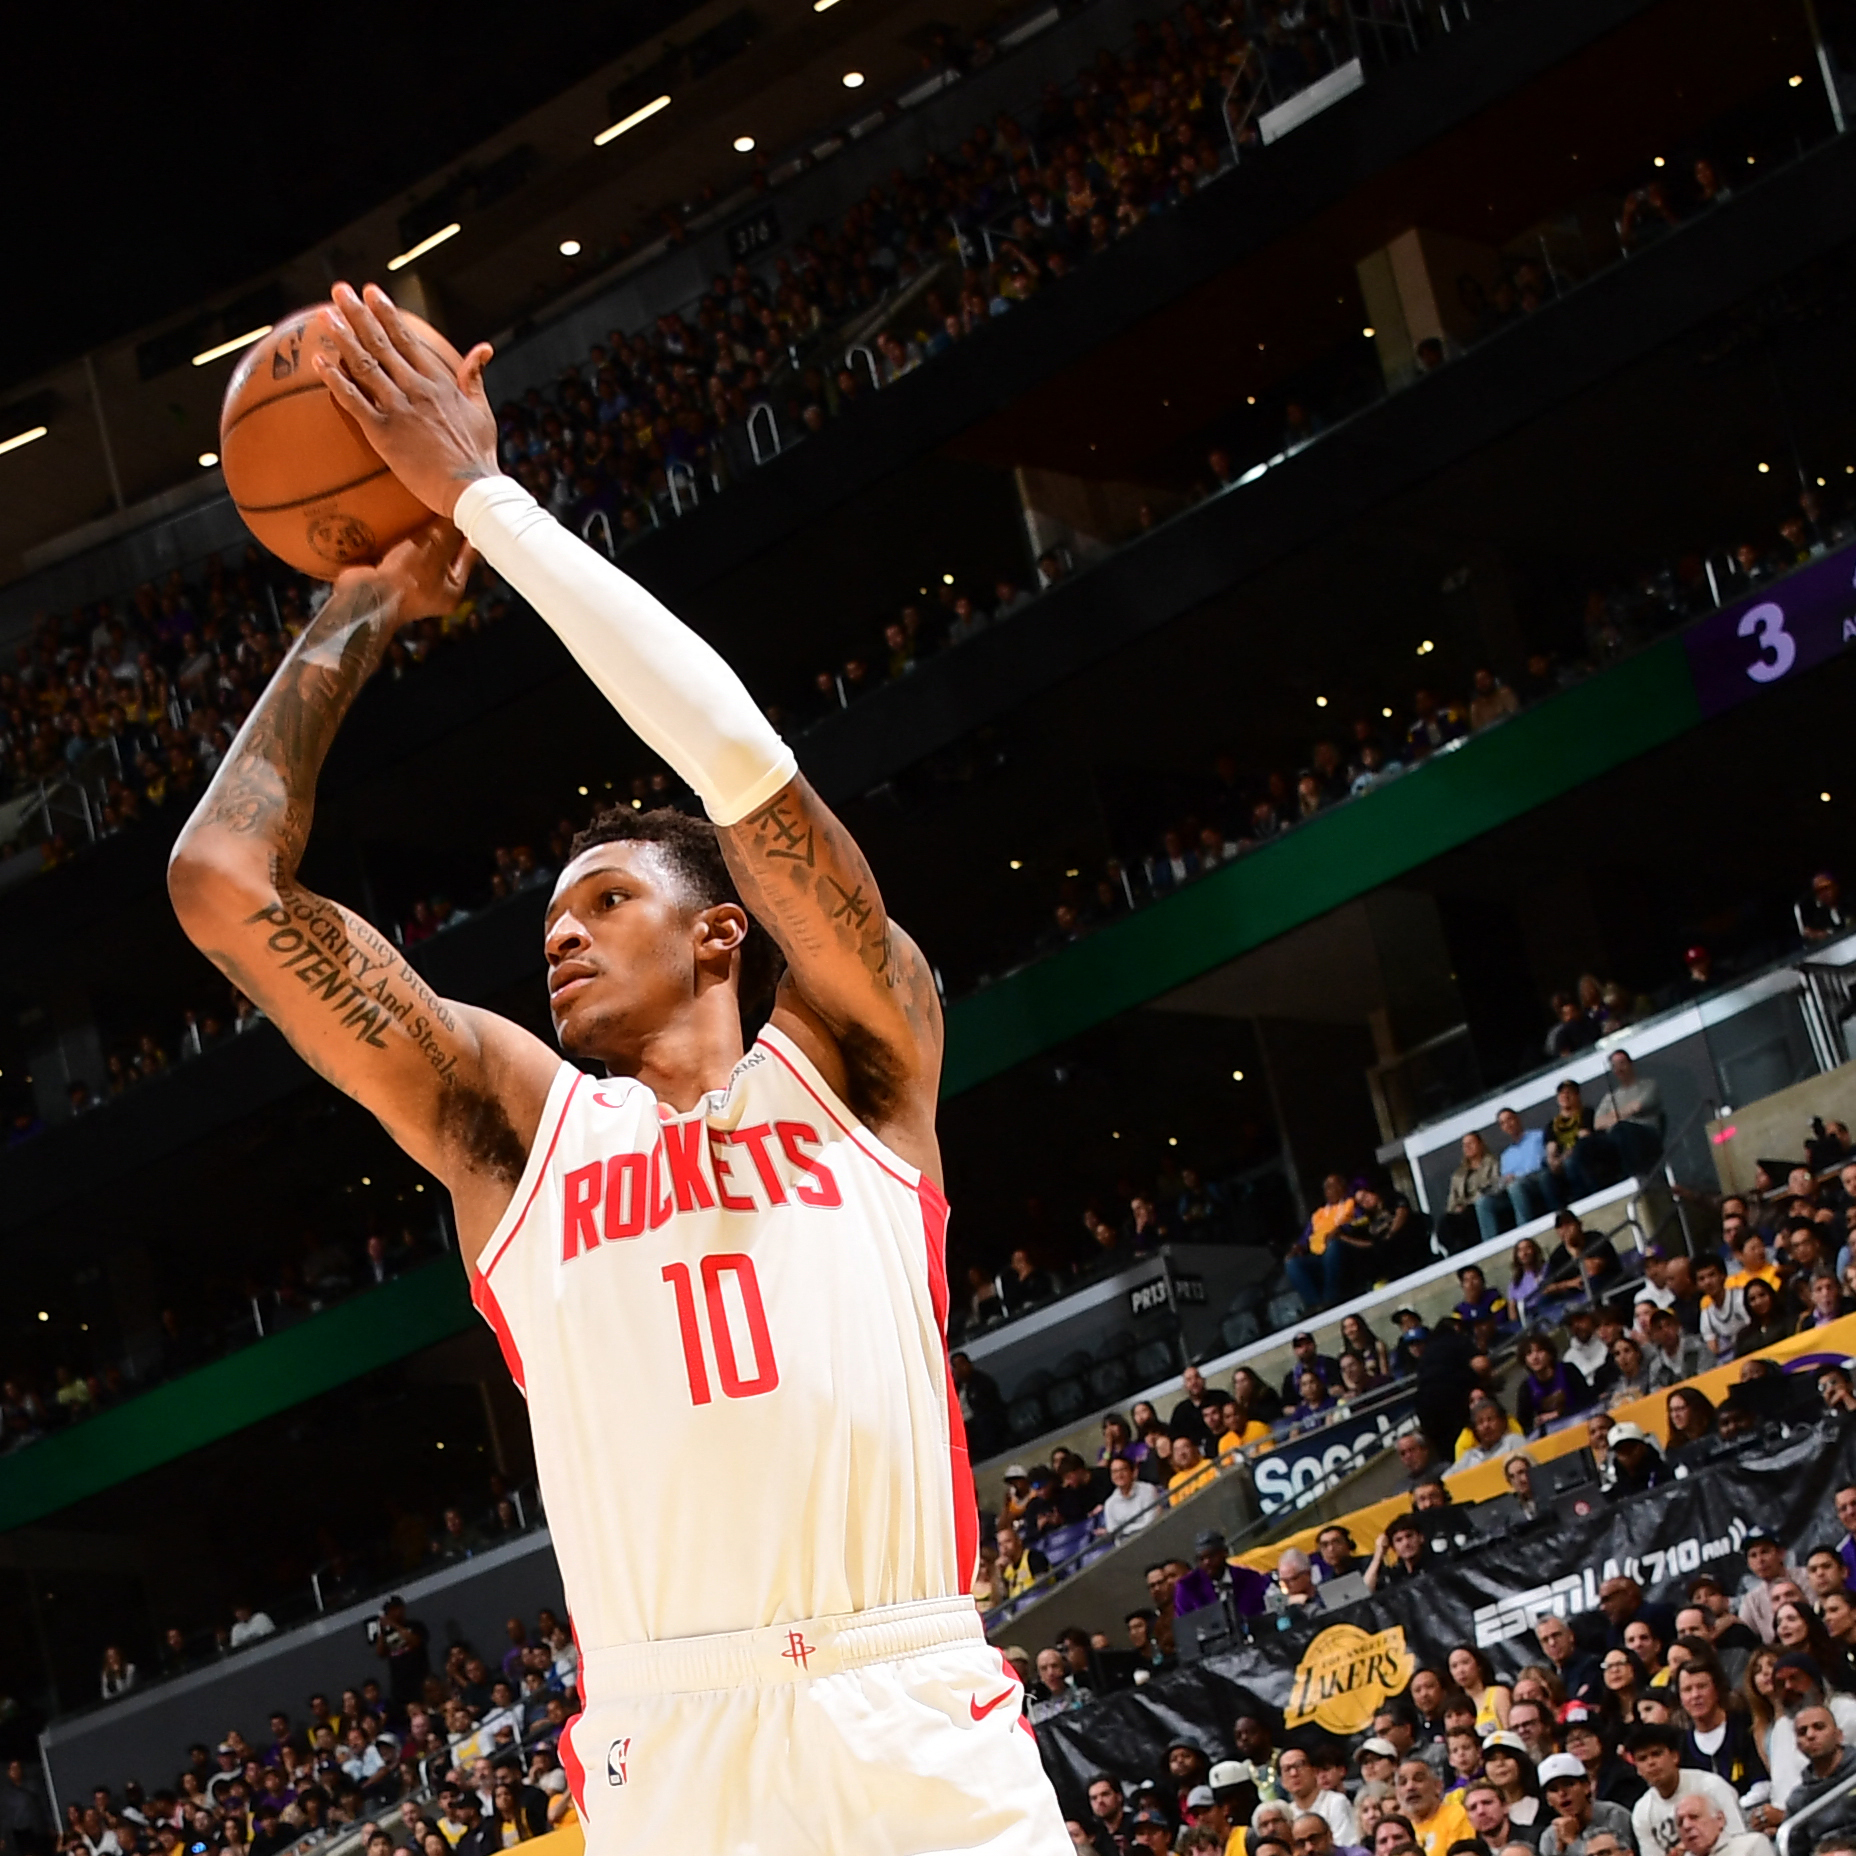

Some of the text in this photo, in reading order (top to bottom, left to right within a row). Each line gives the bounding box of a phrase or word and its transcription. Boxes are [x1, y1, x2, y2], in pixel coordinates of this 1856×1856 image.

[1737, 601, 1797, 684] 3
[245, 902, 389, 1050] POTENTIAL
[366, 976, 414, 1023] And
[406, 1014, 459, 1089] Steals
[562, 1118, 844, 1264] ROCKETS
[662, 1252, 781, 1405] 10
[1131, 1279, 1169, 1314] PR13
[1640, 1537, 1701, 1583] 710
[1294, 1651, 1399, 1718] LAKERS
